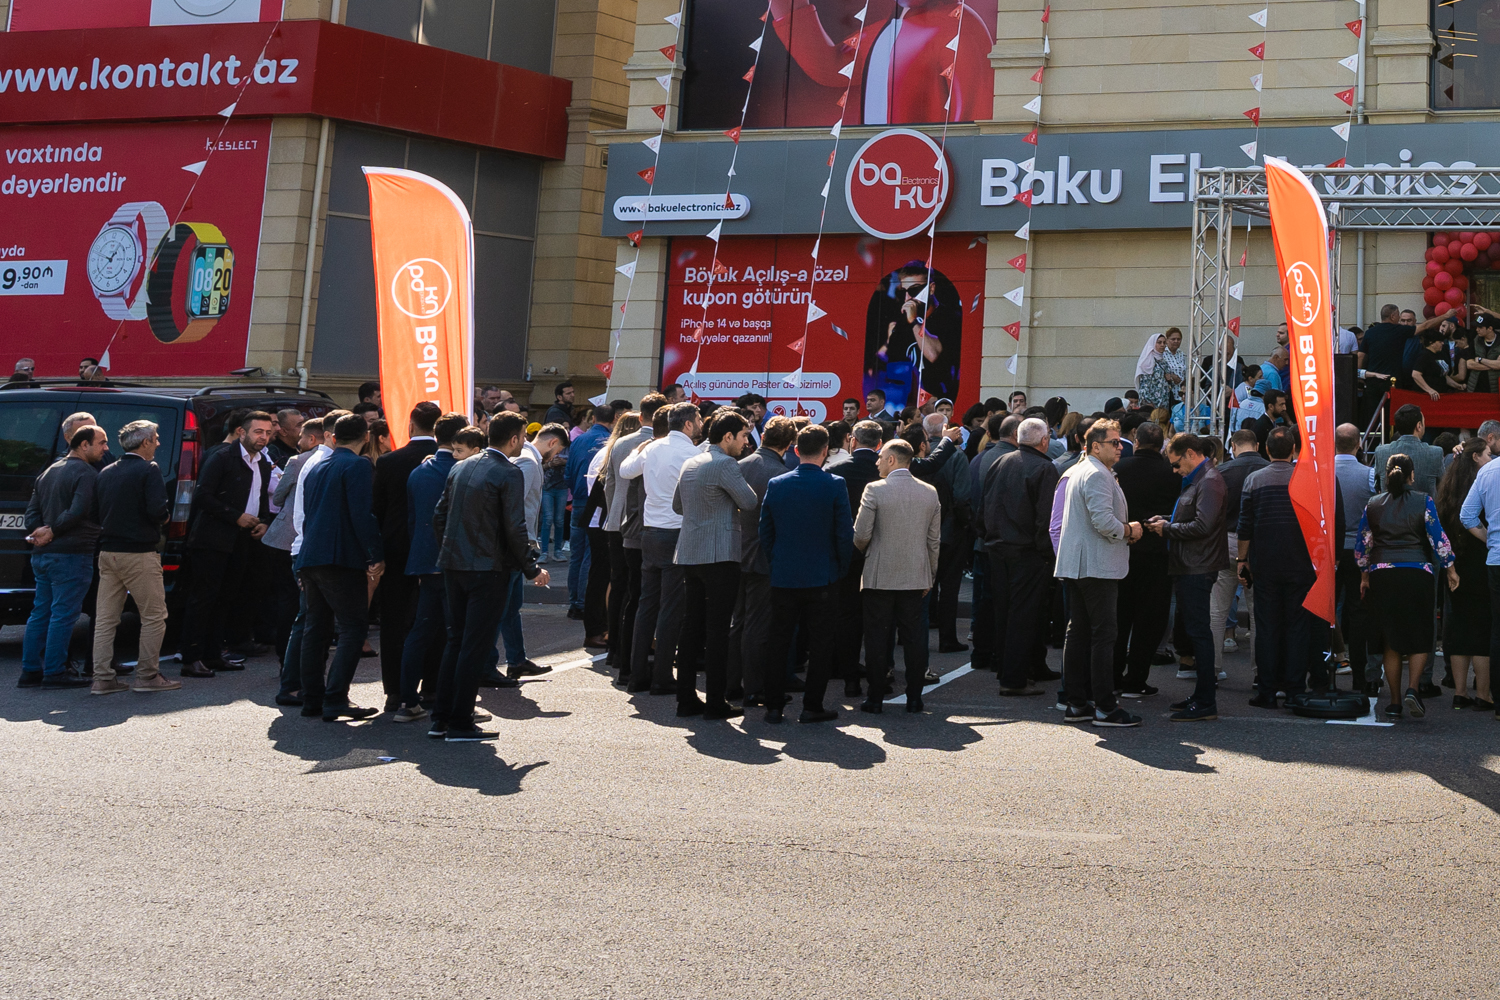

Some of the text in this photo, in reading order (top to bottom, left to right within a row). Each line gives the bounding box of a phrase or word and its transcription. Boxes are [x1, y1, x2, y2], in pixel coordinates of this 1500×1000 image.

[6, 142, 103, 165] vaxtında
[1, 172, 126, 198] dəyərləndir
[902, 176, 940, 186] Electronics
[979, 154, 1123, 206] Baku
[0, 244, 25, 259] yda
[684, 265, 849, 286] Böyük Açılış-a özəl
[683, 289, 737, 308] kupon
[680, 318, 714, 329] iPhone
[716, 318, 727, 328] 14
[728, 320, 741, 328] və
[709, 379, 750, 391] günündə
[751, 379, 781, 389] Paster
